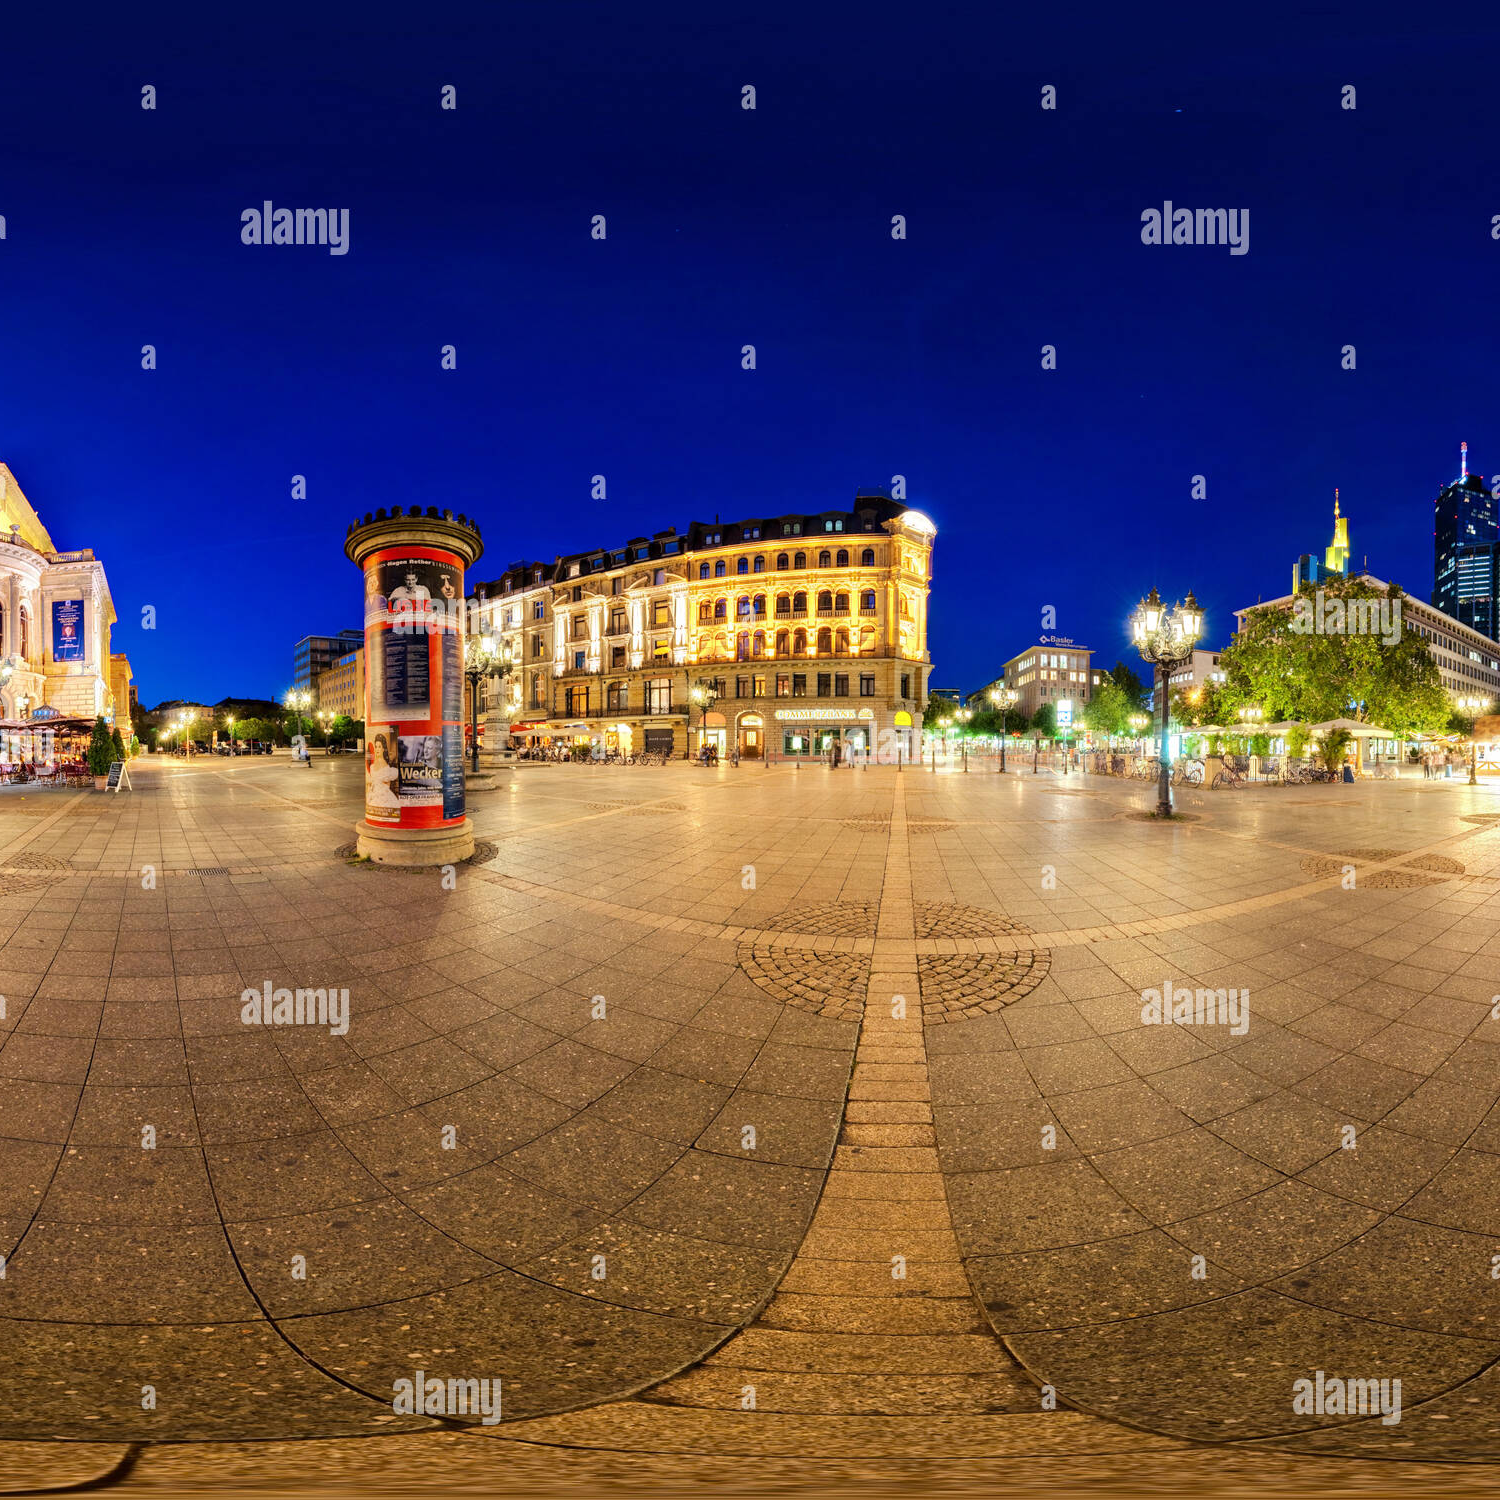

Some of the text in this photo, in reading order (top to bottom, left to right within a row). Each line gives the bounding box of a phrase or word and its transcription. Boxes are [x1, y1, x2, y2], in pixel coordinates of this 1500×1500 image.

[1050, 635, 1074, 644] Basler
[775, 709, 856, 720] COMMERZBANK
[400, 766, 443, 780] Wecker
